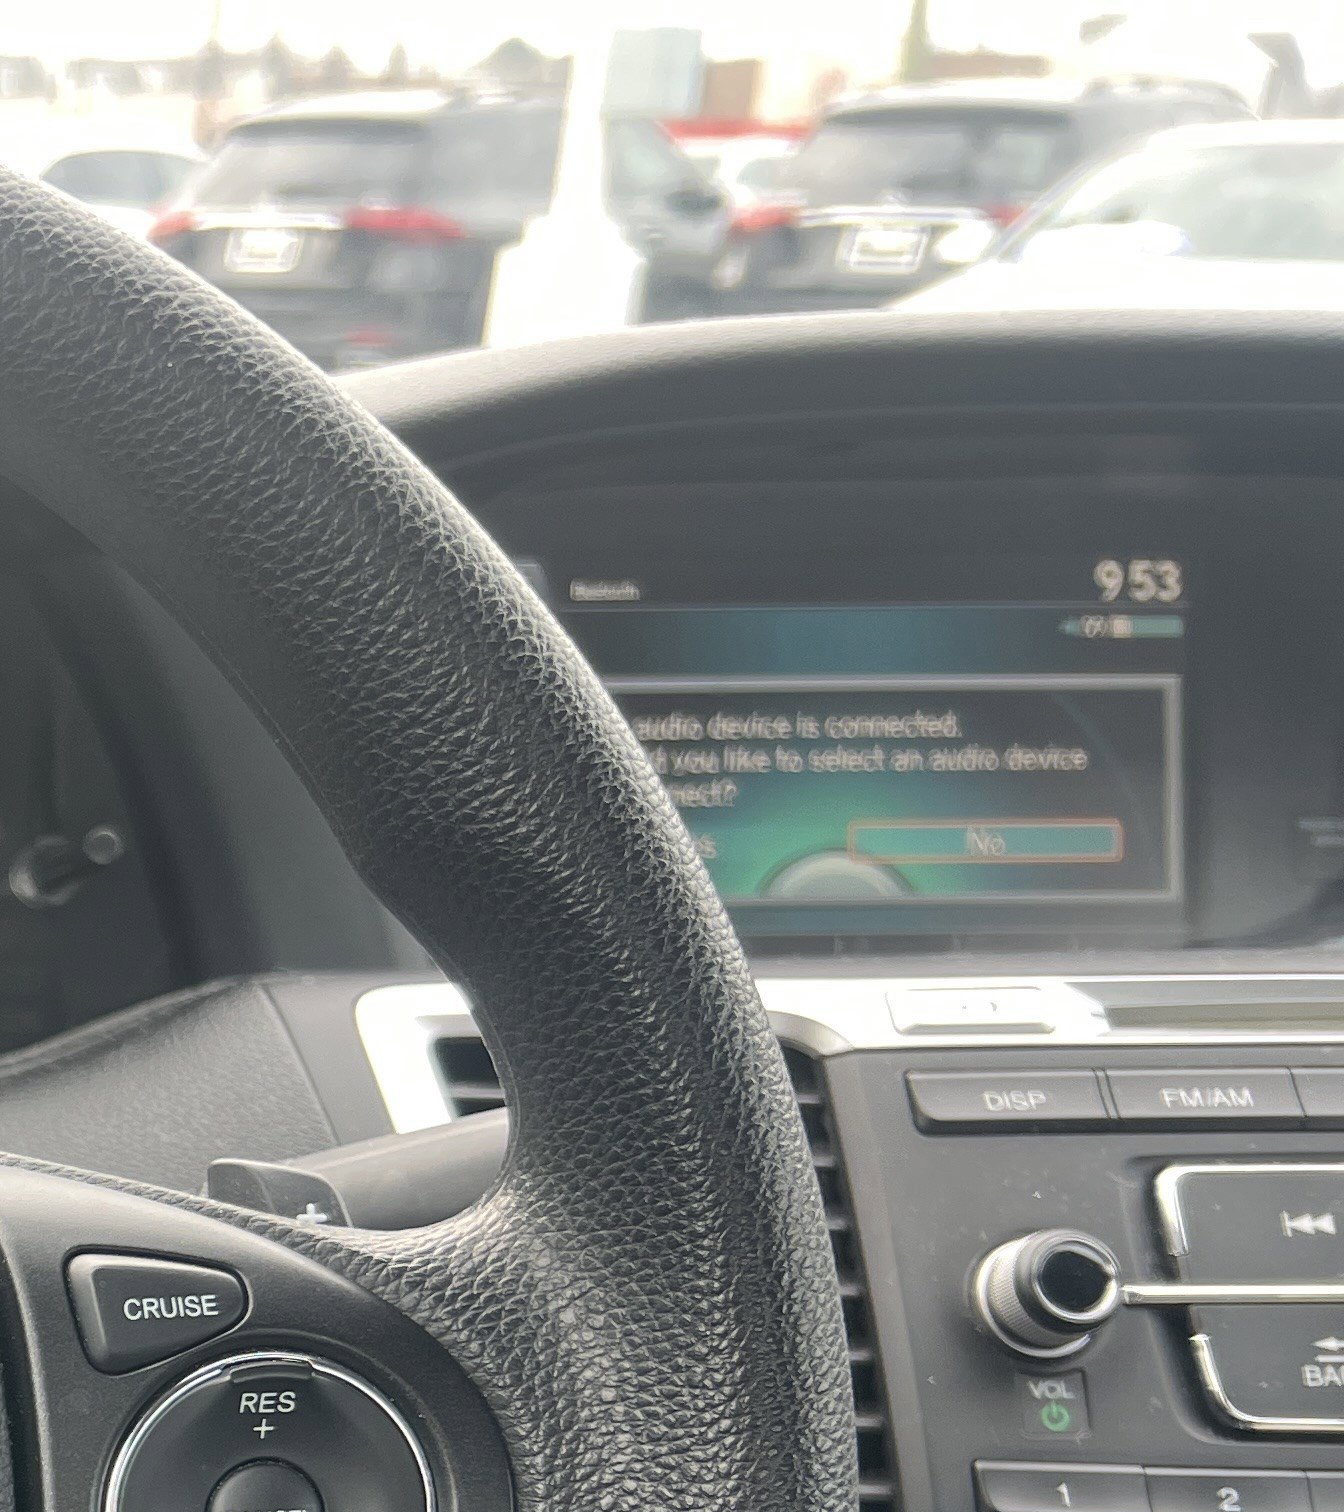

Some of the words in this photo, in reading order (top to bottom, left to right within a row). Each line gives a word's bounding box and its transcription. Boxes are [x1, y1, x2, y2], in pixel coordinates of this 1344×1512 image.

[707, 711, 792, 740] device
[796, 710, 821, 739] is
[724, 745, 771, 773] like
[775, 745, 804, 773] to
[808, 744, 885, 773] select
[890, 748, 925, 773] an
[927, 744, 1000, 772] audio
[1003, 744, 1089, 772] device
[966, 826, 1006, 856] No
[984, 1091, 1047, 1112] DISP
[1162, 1087, 1255, 1109] FM/AM
[123, 1295, 219, 1320] CRUISE
[1028, 1380, 1075, 1399] VOL
[239, 1392, 296, 1414] RES
[1056, 1482, 1072, 1508] 1
[1217, 1486, 1243, 1512] 2
